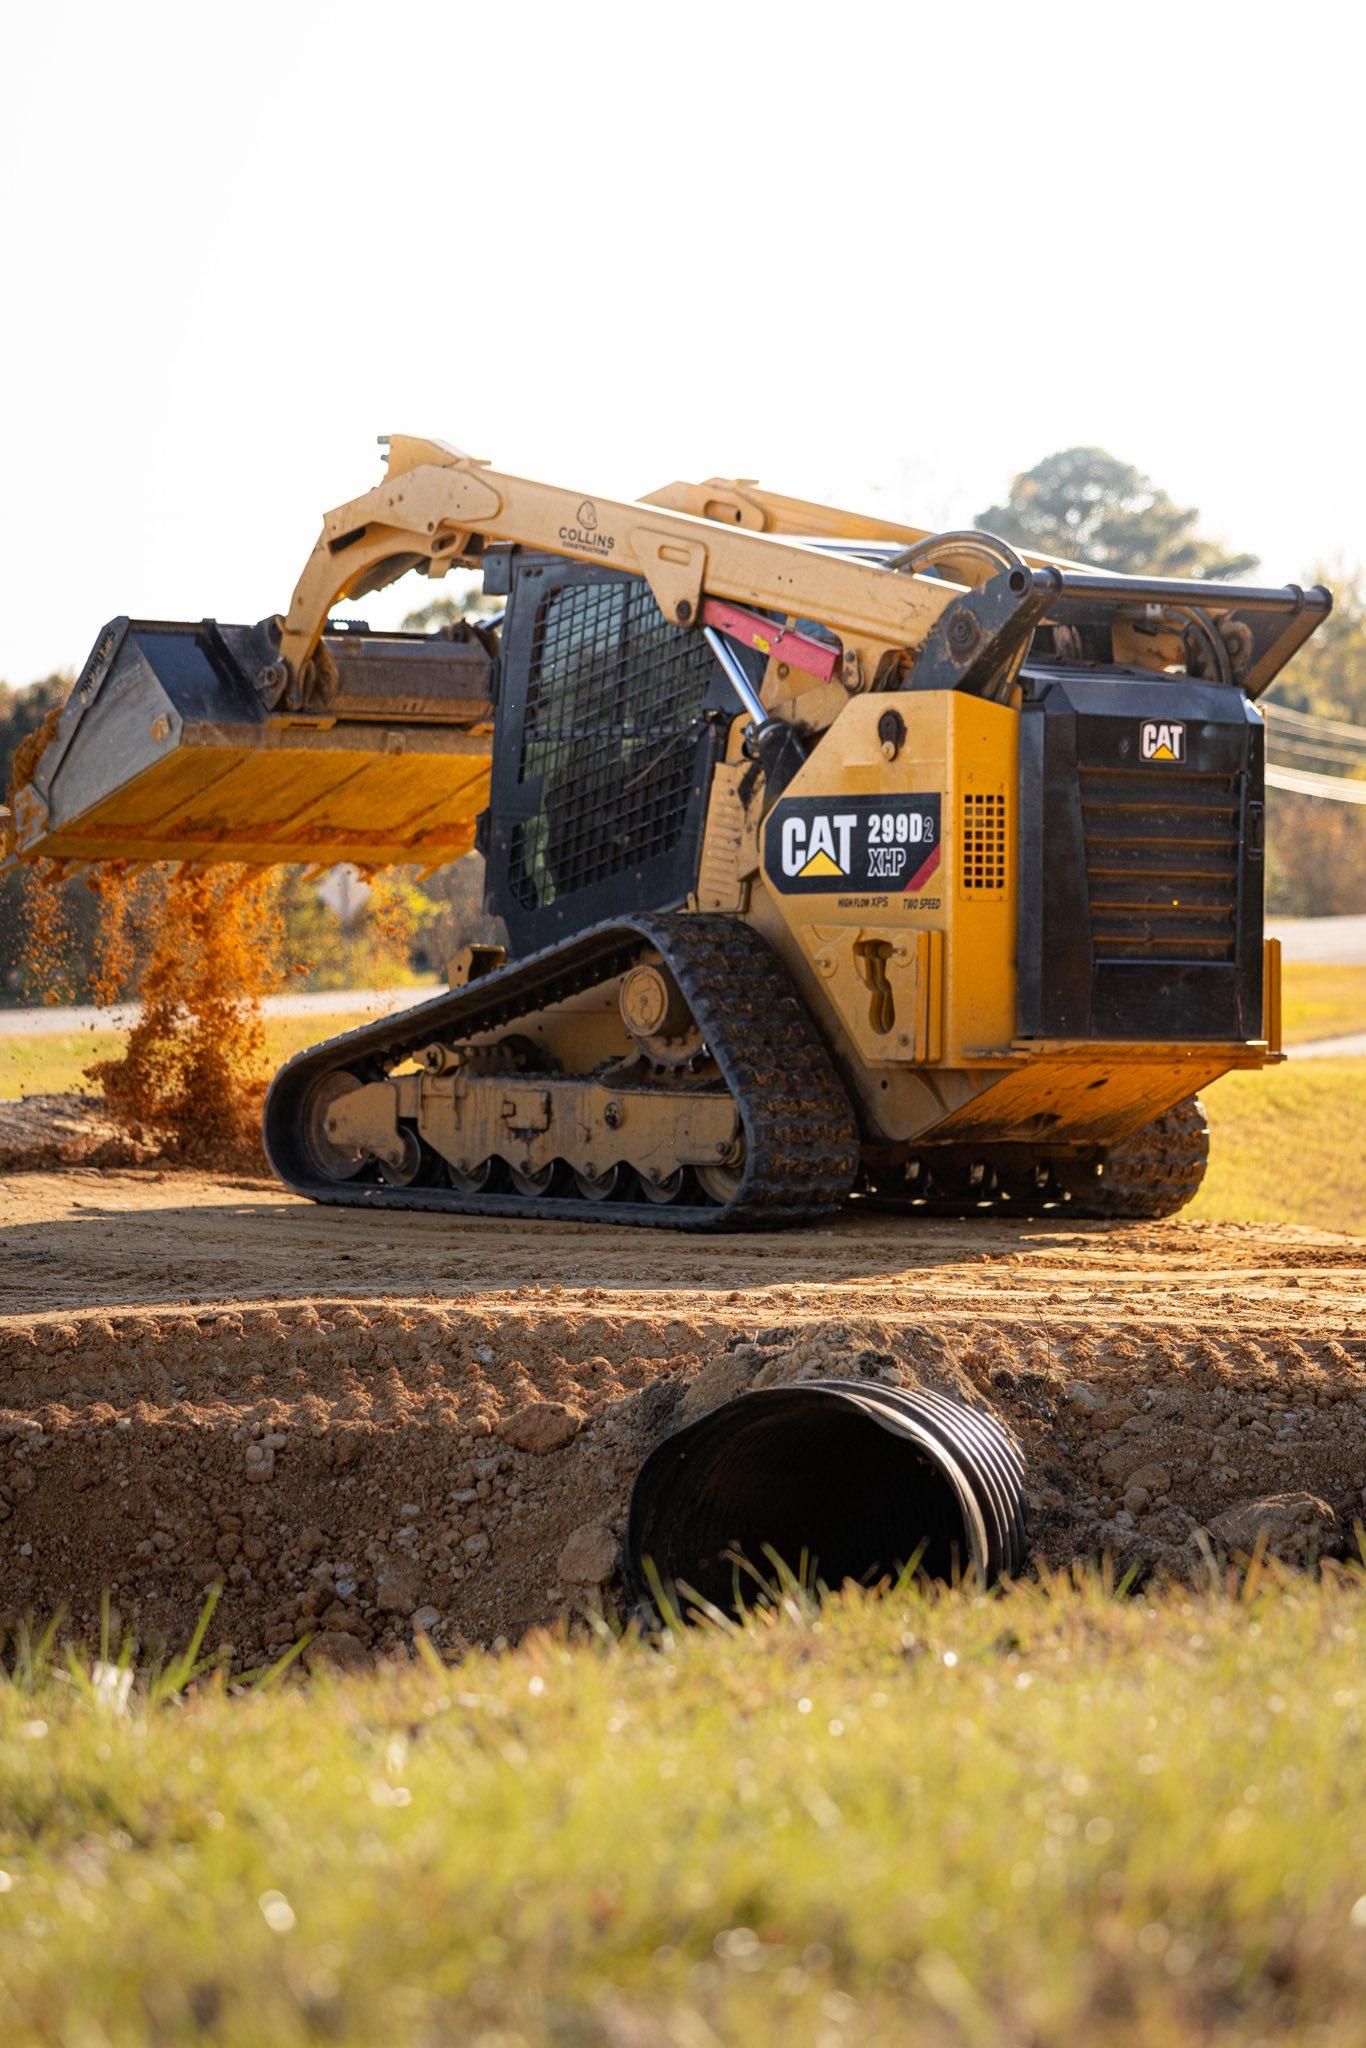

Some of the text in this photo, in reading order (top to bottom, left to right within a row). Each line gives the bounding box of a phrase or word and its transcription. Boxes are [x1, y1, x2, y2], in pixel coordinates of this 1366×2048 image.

[558, 526, 615, 549] COLLINS
[1142, 723, 1183, 759] CAT
[781, 814, 857, 877] CAT
[867, 847, 907, 877] XHP
[838, 896, 889, 908] HIGH FLOW XPS
[903, 898, 941, 909] TWO SPEED
